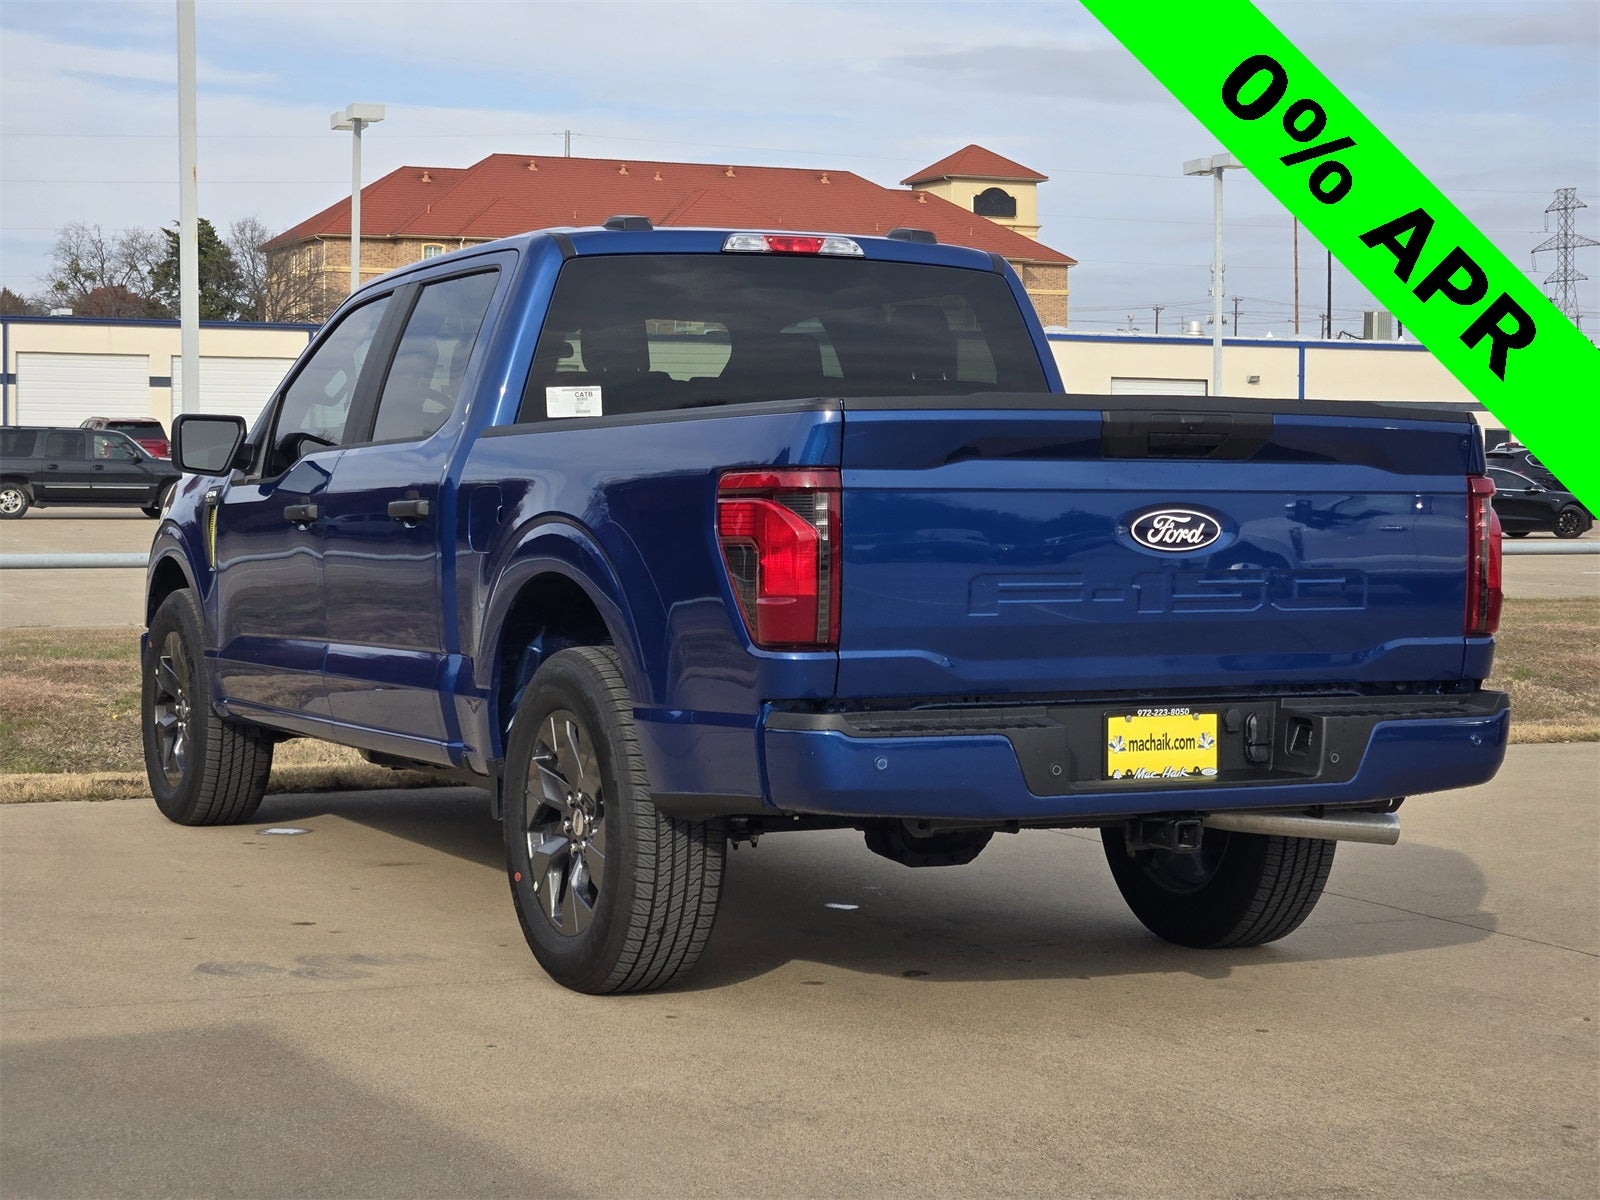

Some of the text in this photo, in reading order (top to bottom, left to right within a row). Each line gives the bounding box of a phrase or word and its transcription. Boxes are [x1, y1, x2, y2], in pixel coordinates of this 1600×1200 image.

[1147, 515, 1205, 543] Ford
[968, 569, 1368, 616] F-150
[1137, 708, 1190, 717] 972-223-8050
[1128, 732, 1196, 752] machaik.com
